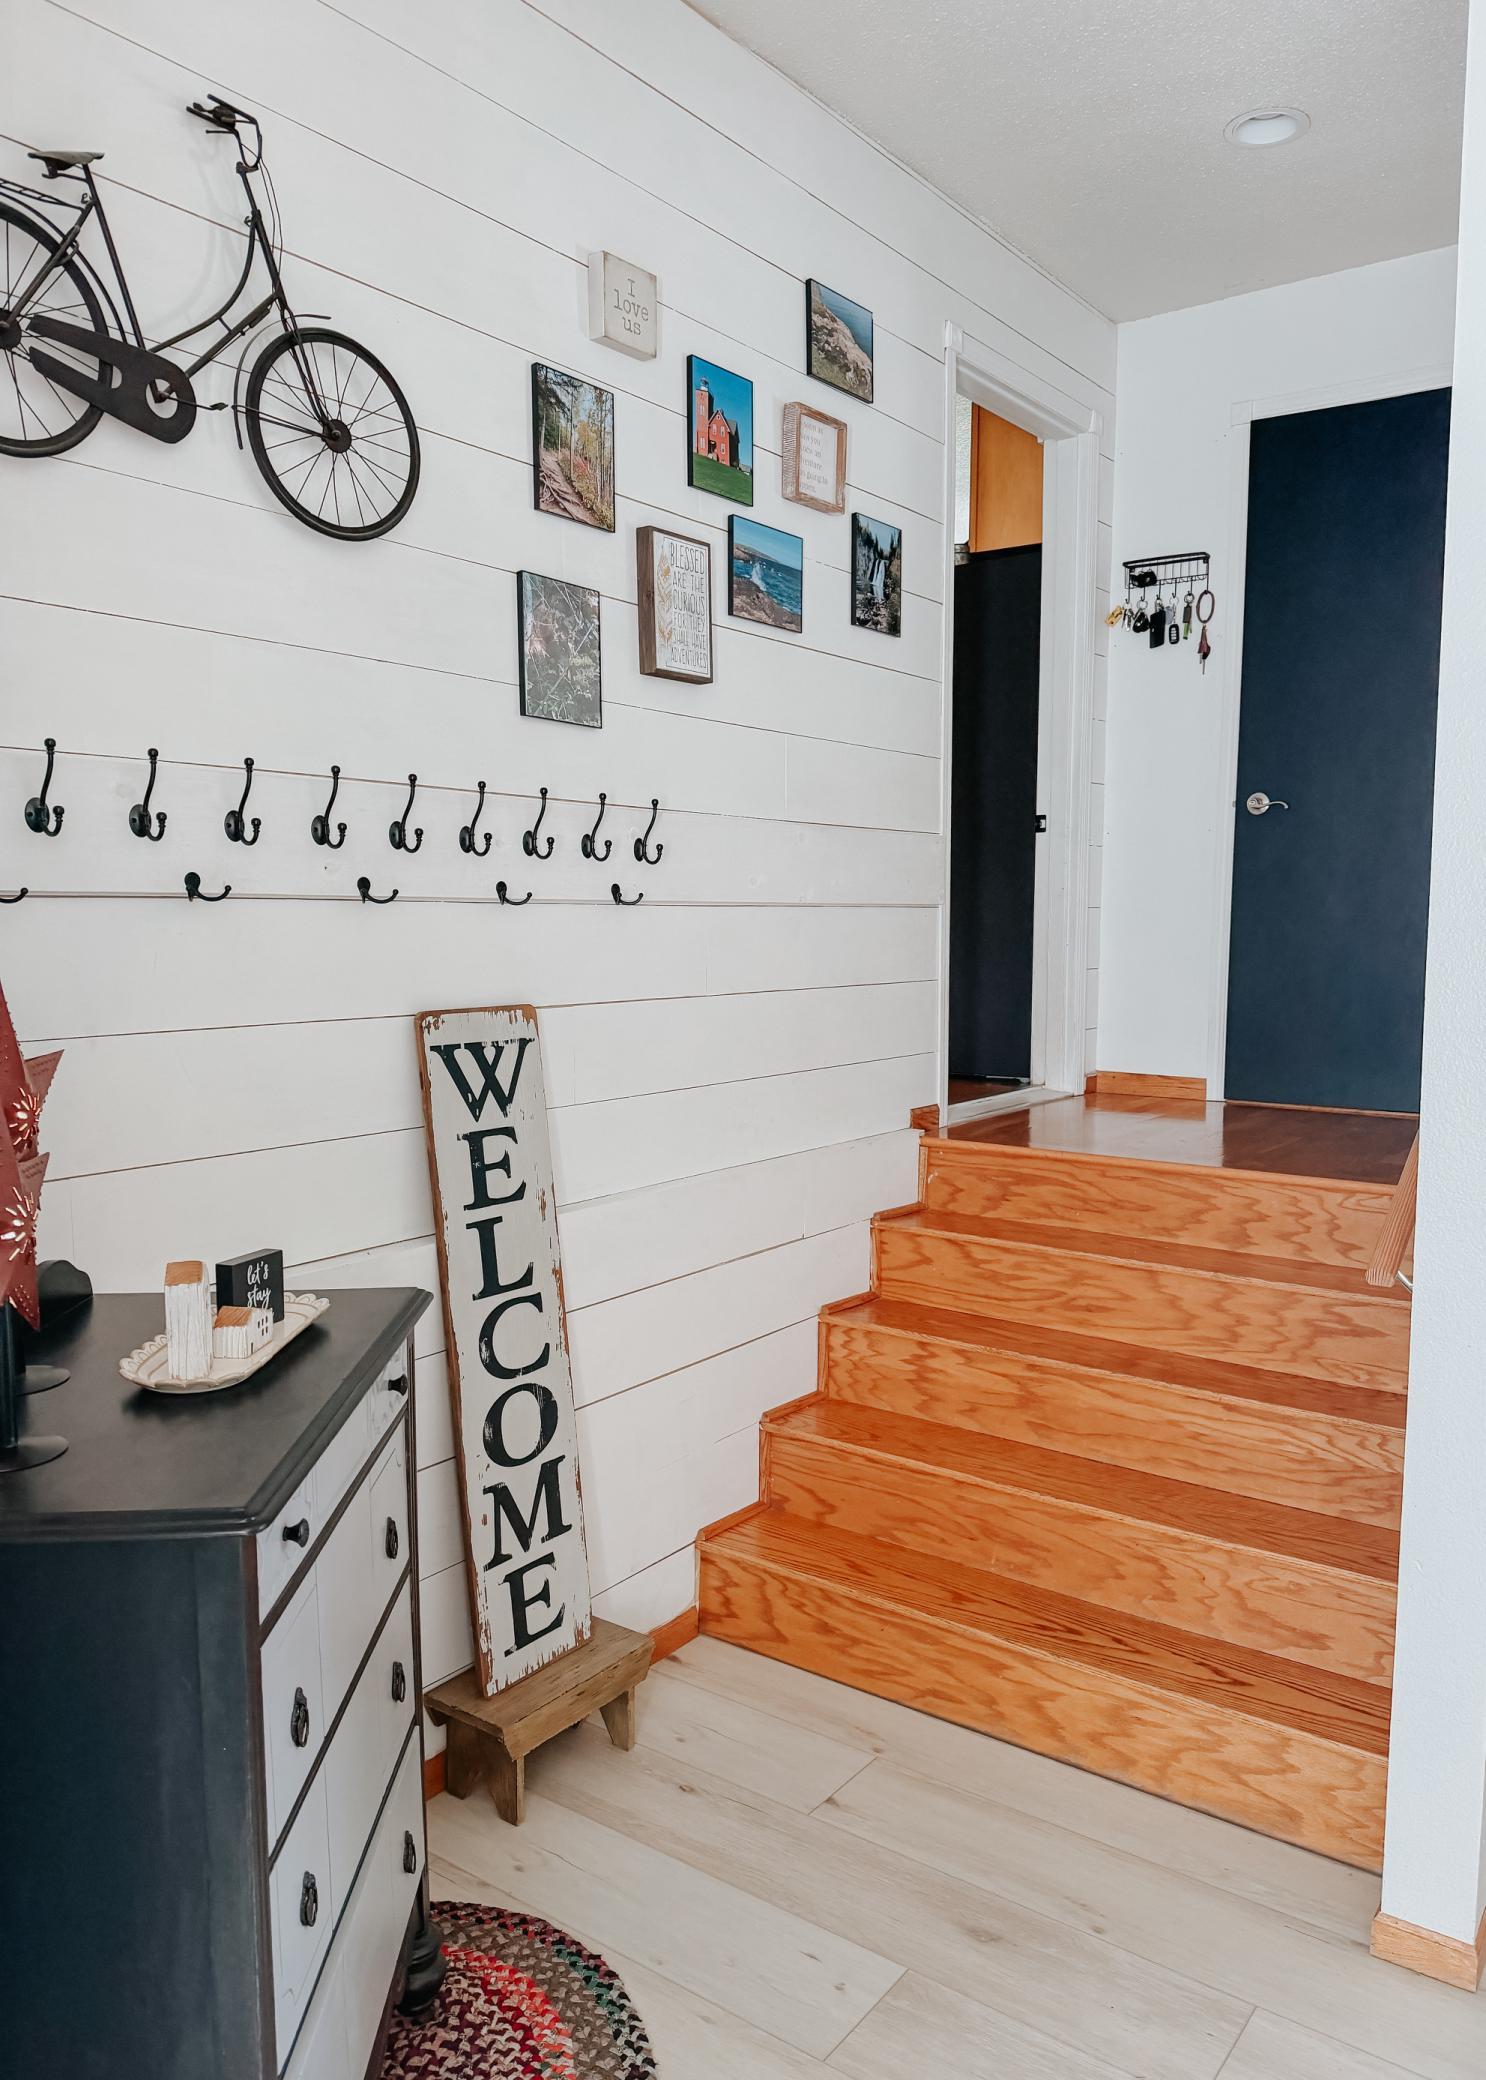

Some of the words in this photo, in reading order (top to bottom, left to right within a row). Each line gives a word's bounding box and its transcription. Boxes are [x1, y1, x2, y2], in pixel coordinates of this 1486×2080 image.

[628, 278, 635, 297] I
[613, 288, 649, 322] love
[622, 316, 642, 335] us
[671, 541, 705, 575] BLESSED
[673, 570, 686, 589] ARE
[690, 574, 705, 594] THE
[673, 588, 706, 616] CURIOUS
[673, 611, 687, 629] FOR
[689, 613, 706, 633] THEY
[247, 1261, 269, 1285] let's
[247, 1284, 271, 1310] stay
[430, 1036, 573, 1658] WELCOME
